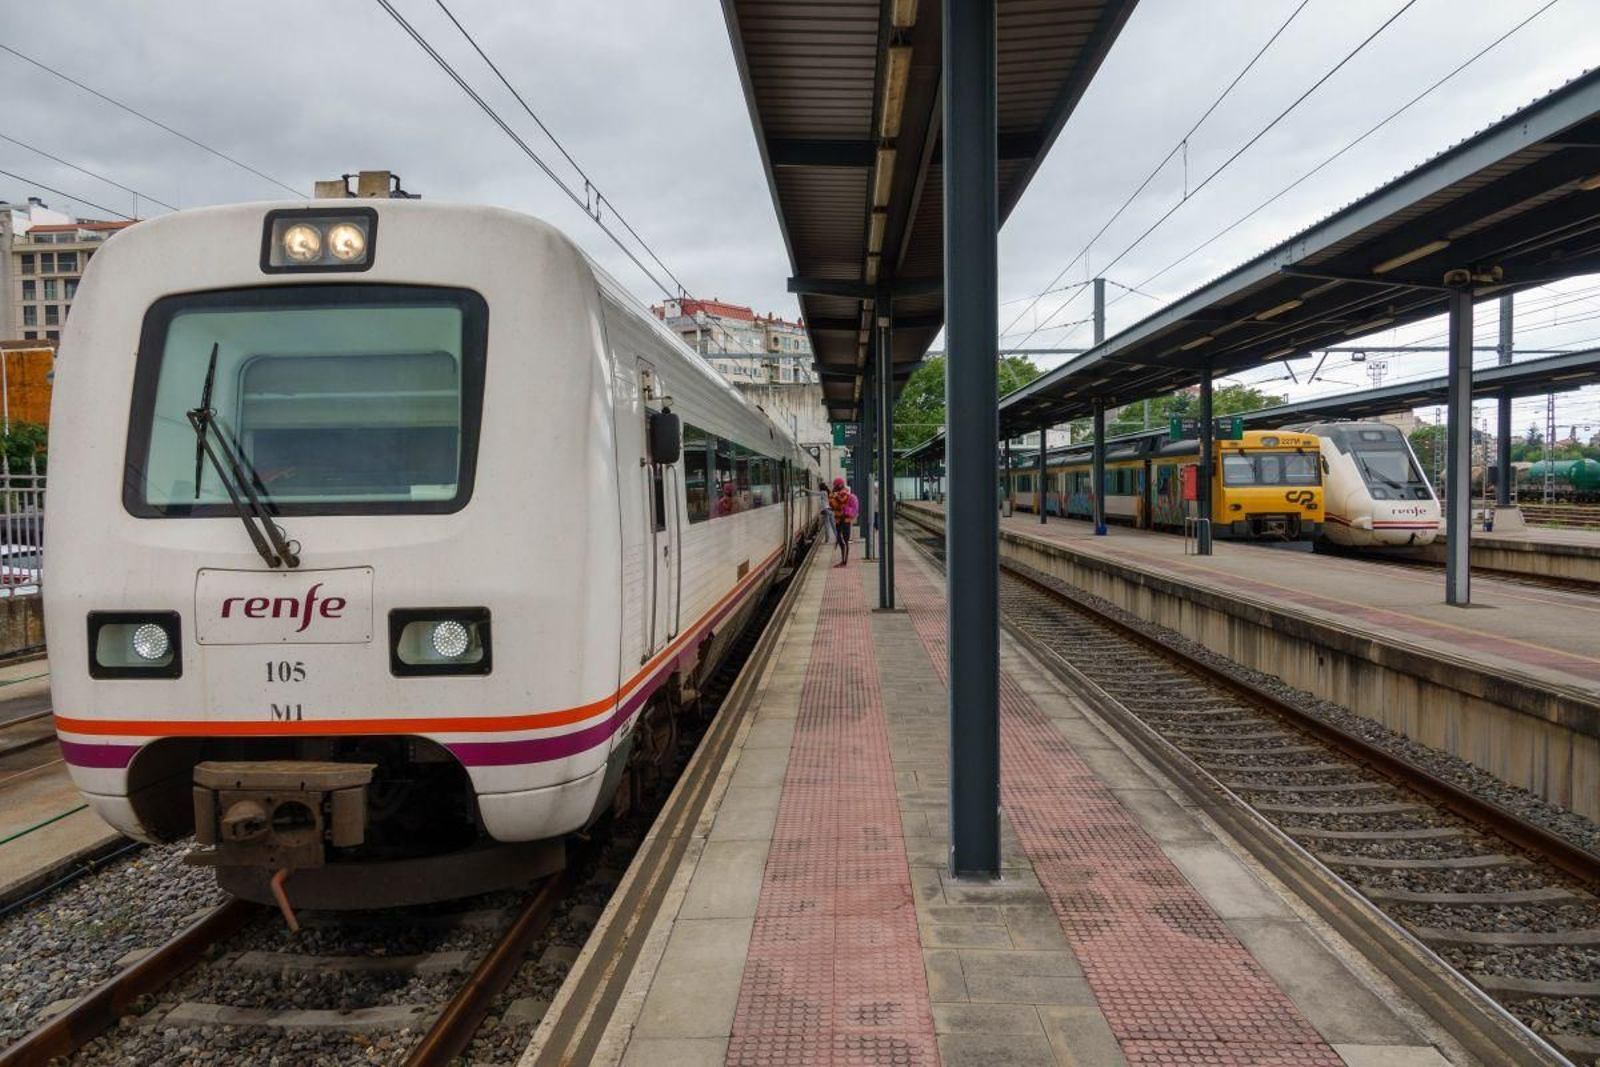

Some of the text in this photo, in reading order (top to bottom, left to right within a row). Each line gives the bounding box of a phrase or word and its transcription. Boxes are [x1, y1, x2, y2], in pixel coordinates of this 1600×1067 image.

[1391, 506, 1427, 517] renfe
[221, 582, 347, 632] renfe
[266, 661, 306, 682] 105
